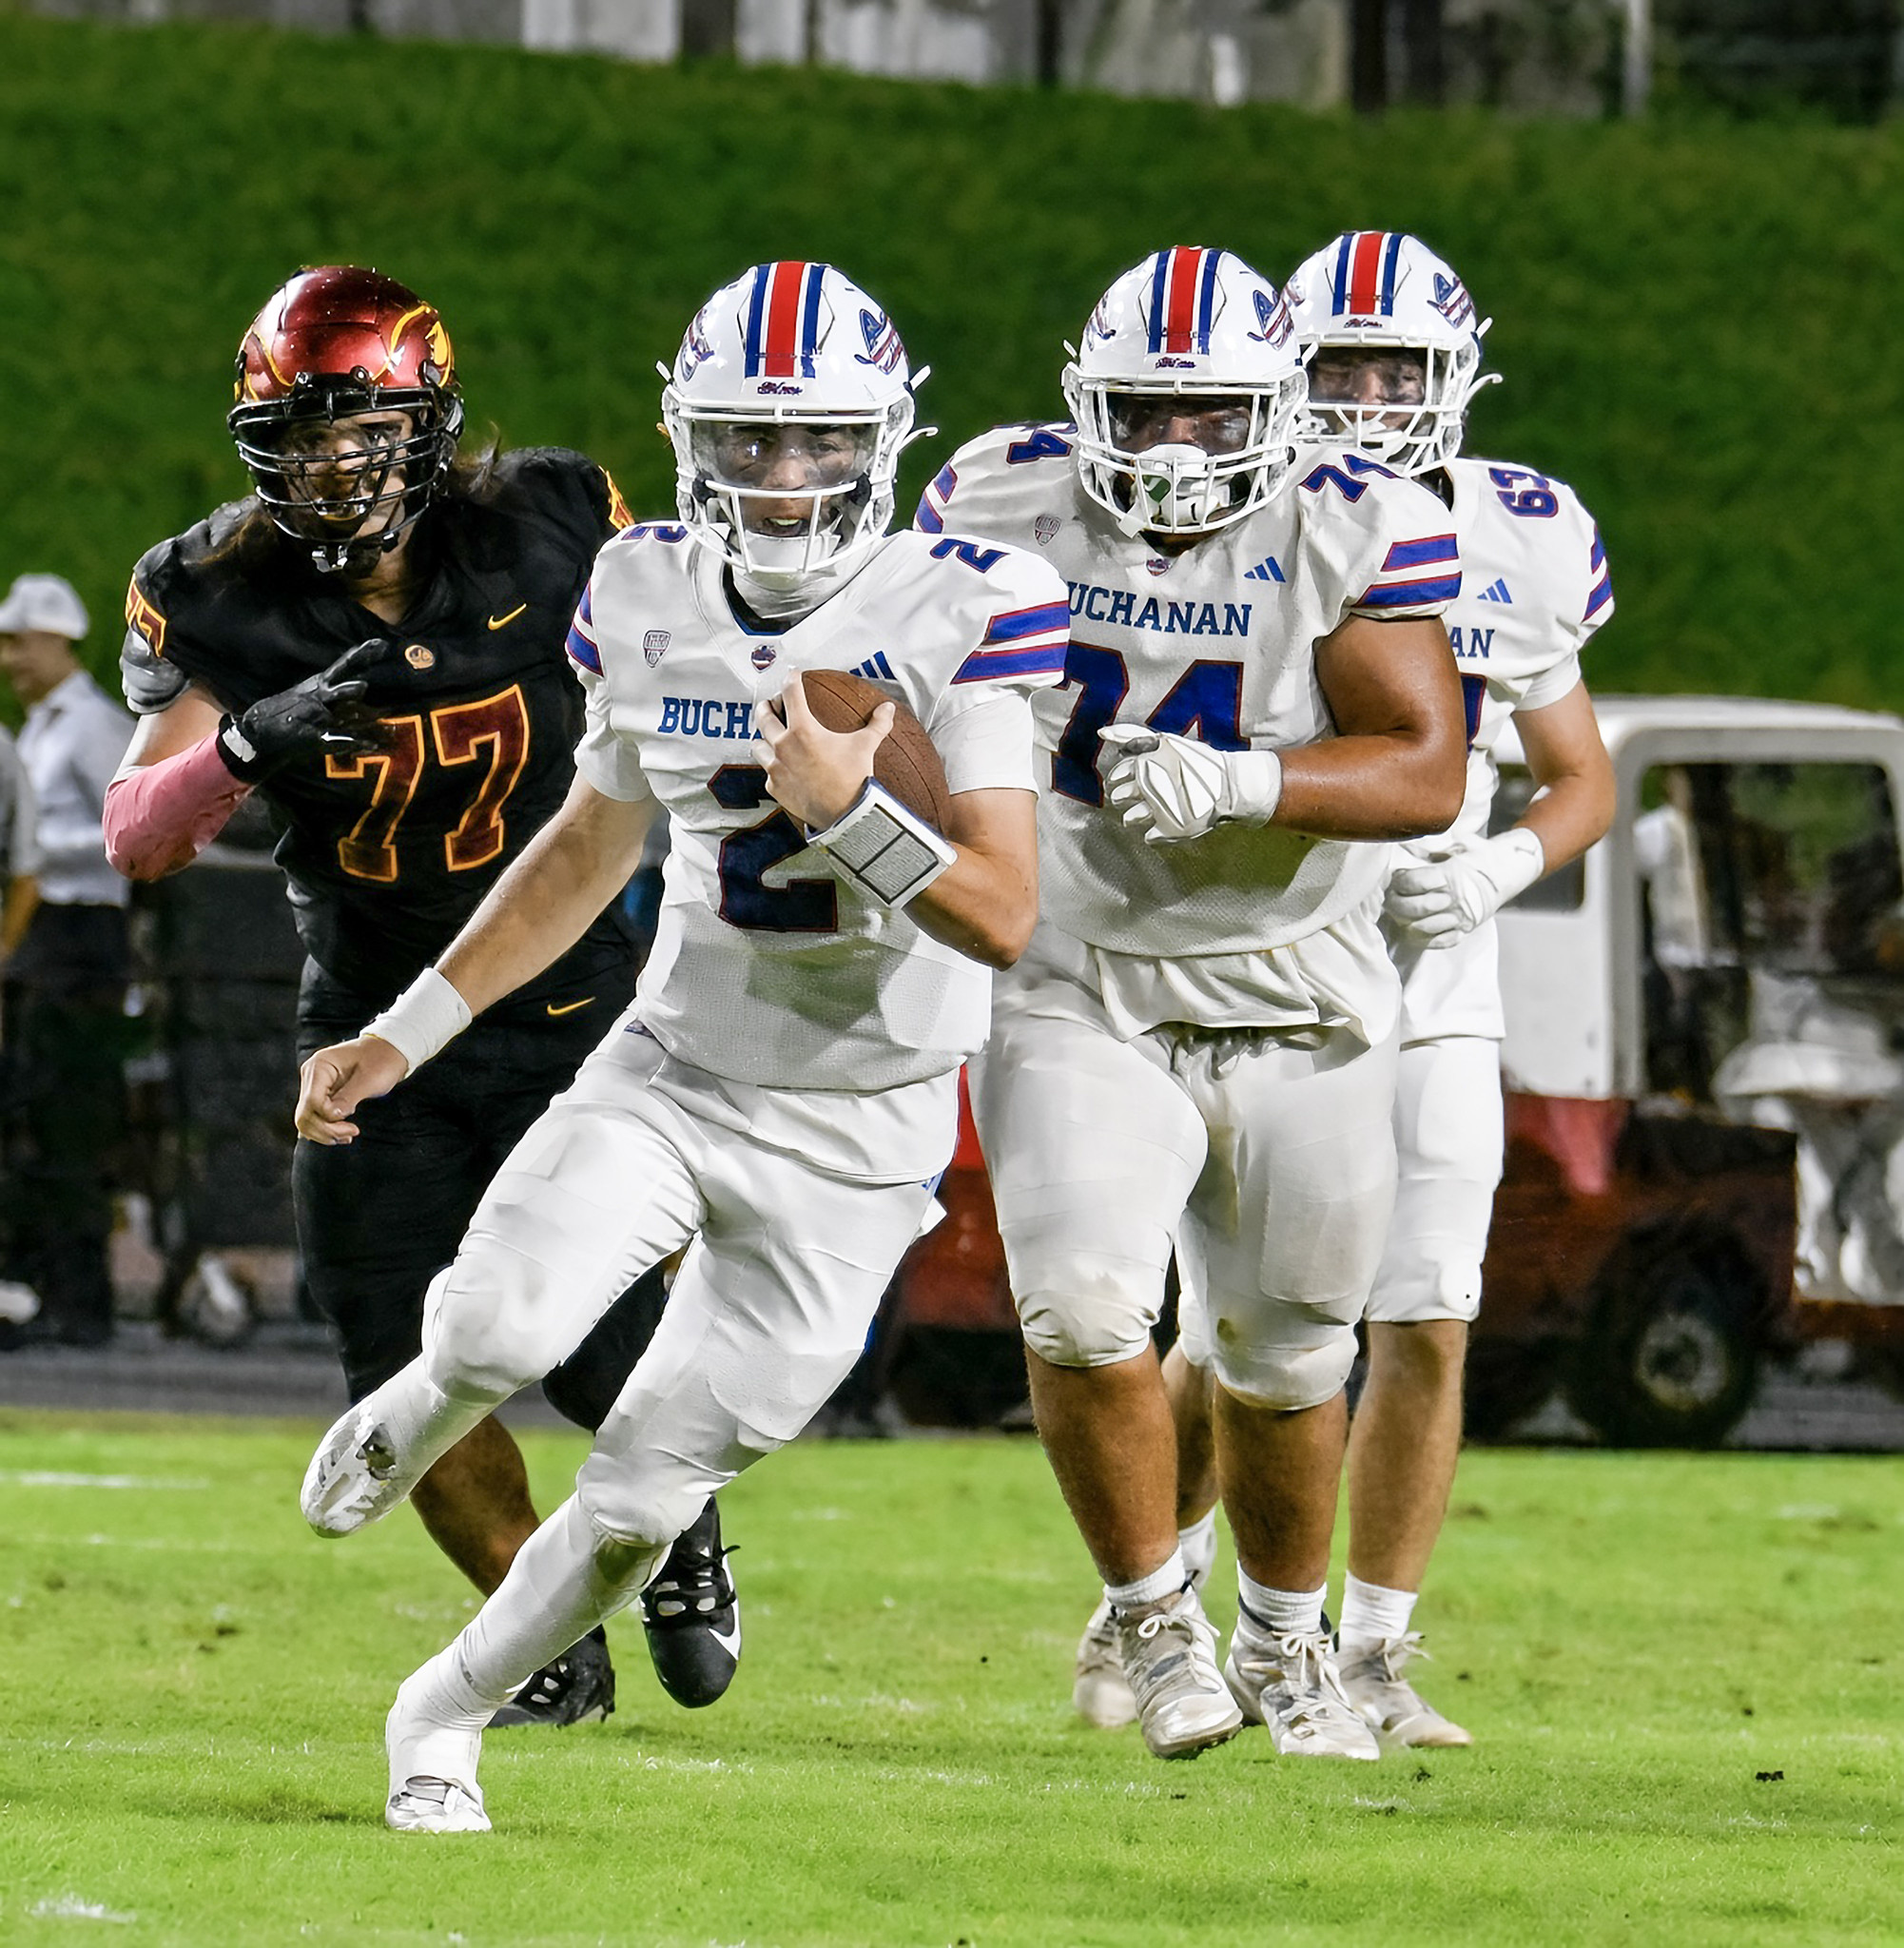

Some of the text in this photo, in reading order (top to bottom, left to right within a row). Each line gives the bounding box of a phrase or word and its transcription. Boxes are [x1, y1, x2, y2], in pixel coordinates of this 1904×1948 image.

[930, 538, 1010, 574] 2
[1067, 581, 1252, 636] UCHANAN
[1449, 627, 1494, 658] AN
[657, 696, 764, 741] BUCH
[1051, 640, 1252, 808] 74
[325, 684, 530, 882] 77
[708, 765, 837, 932] 2
